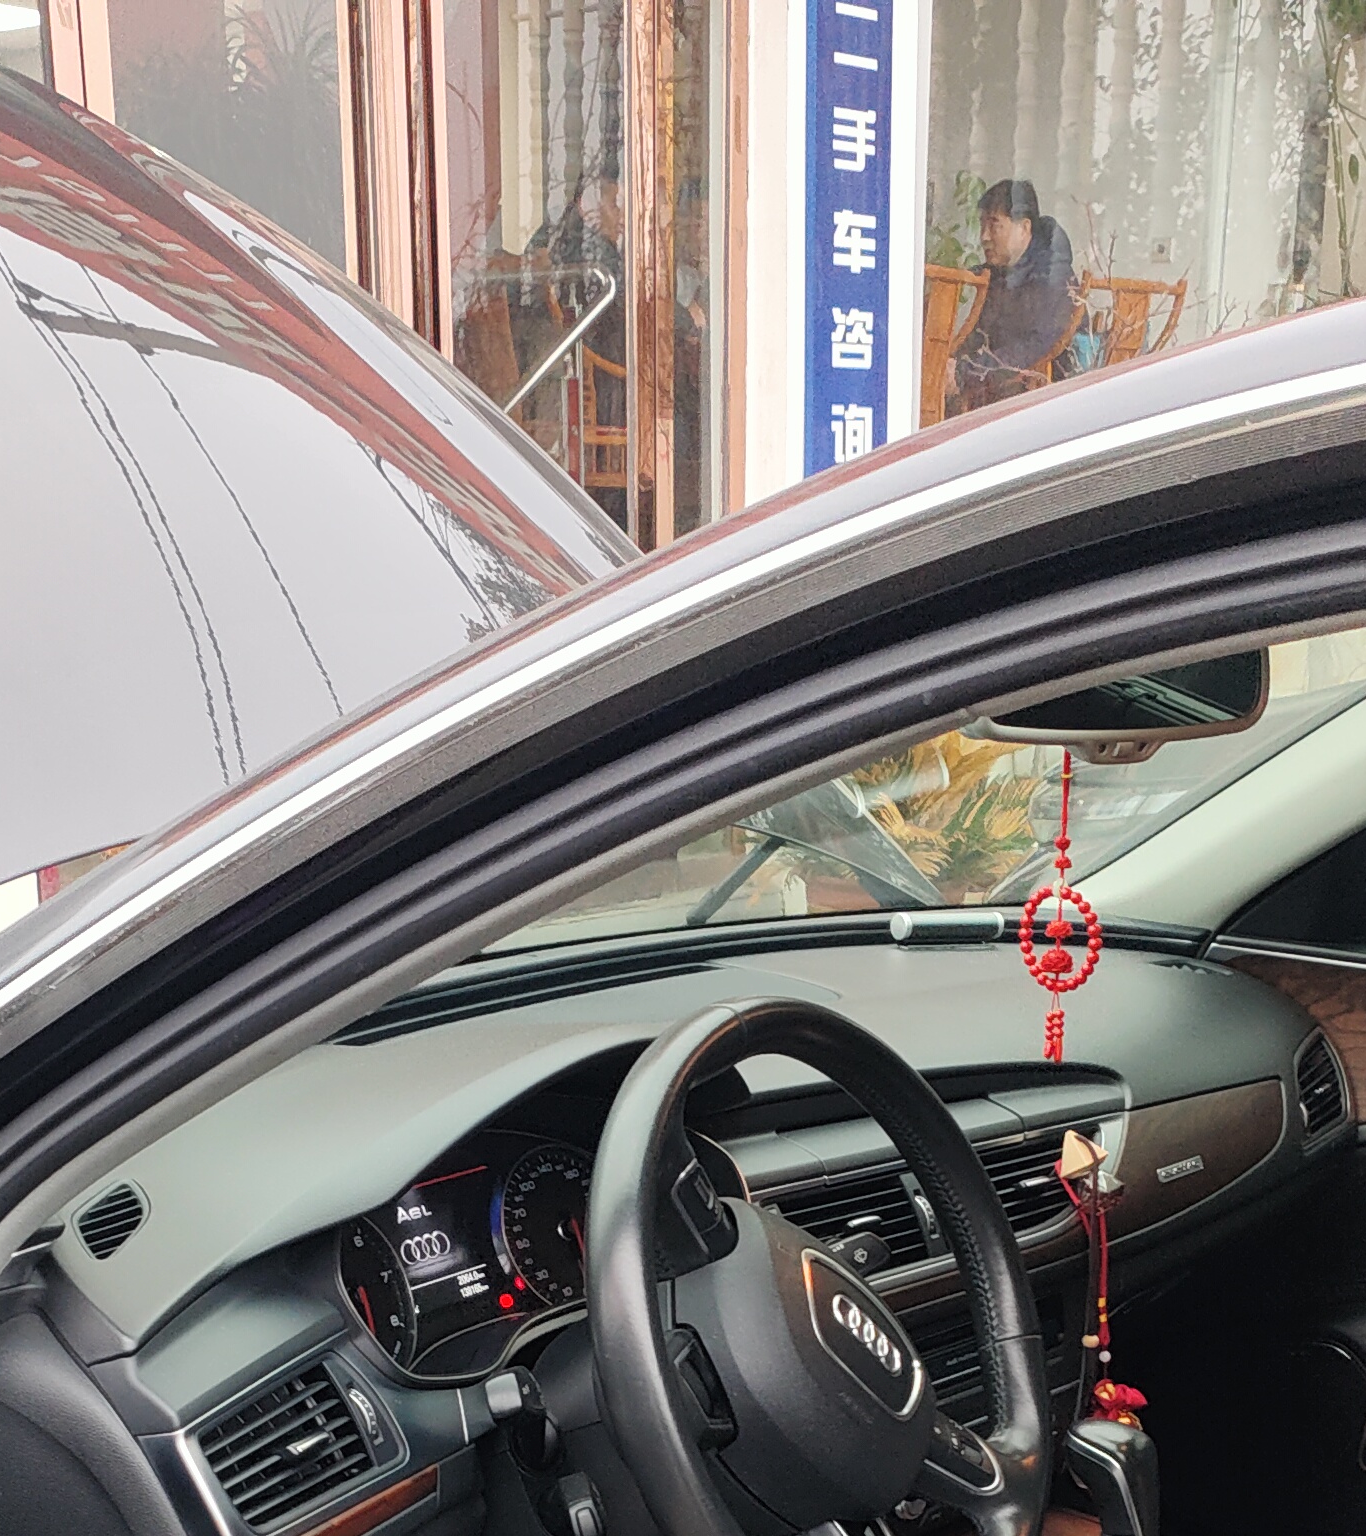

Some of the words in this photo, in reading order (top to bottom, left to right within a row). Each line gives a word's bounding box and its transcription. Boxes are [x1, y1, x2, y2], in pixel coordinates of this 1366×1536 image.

[831, 4, 879, 464] 二手车咨询
